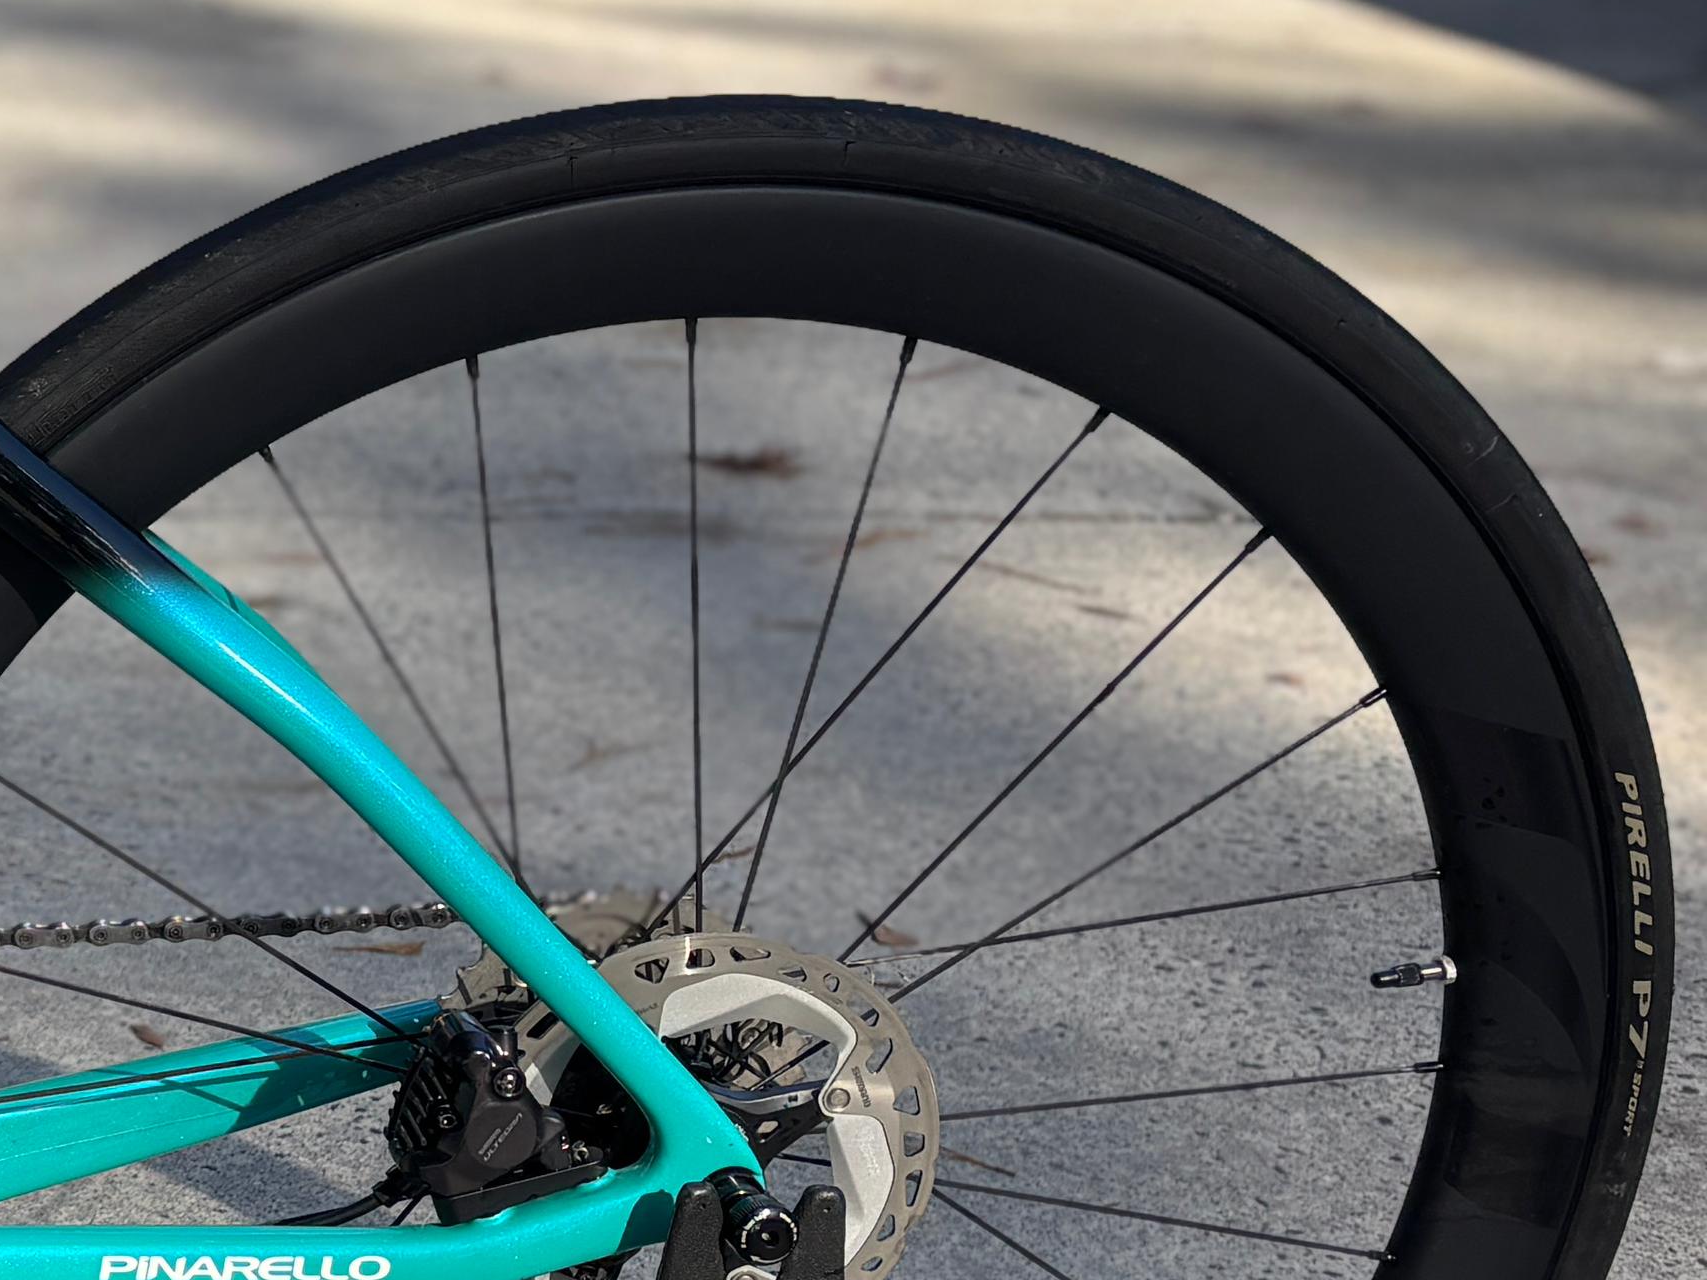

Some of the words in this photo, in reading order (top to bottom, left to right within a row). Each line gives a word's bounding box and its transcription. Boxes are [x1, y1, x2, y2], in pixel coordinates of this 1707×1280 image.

[1612, 770, 1655, 957] PIRELLI
[1628, 979, 1652, 1061] P7
[1622, 1074, 1642, 1137] SPORT
